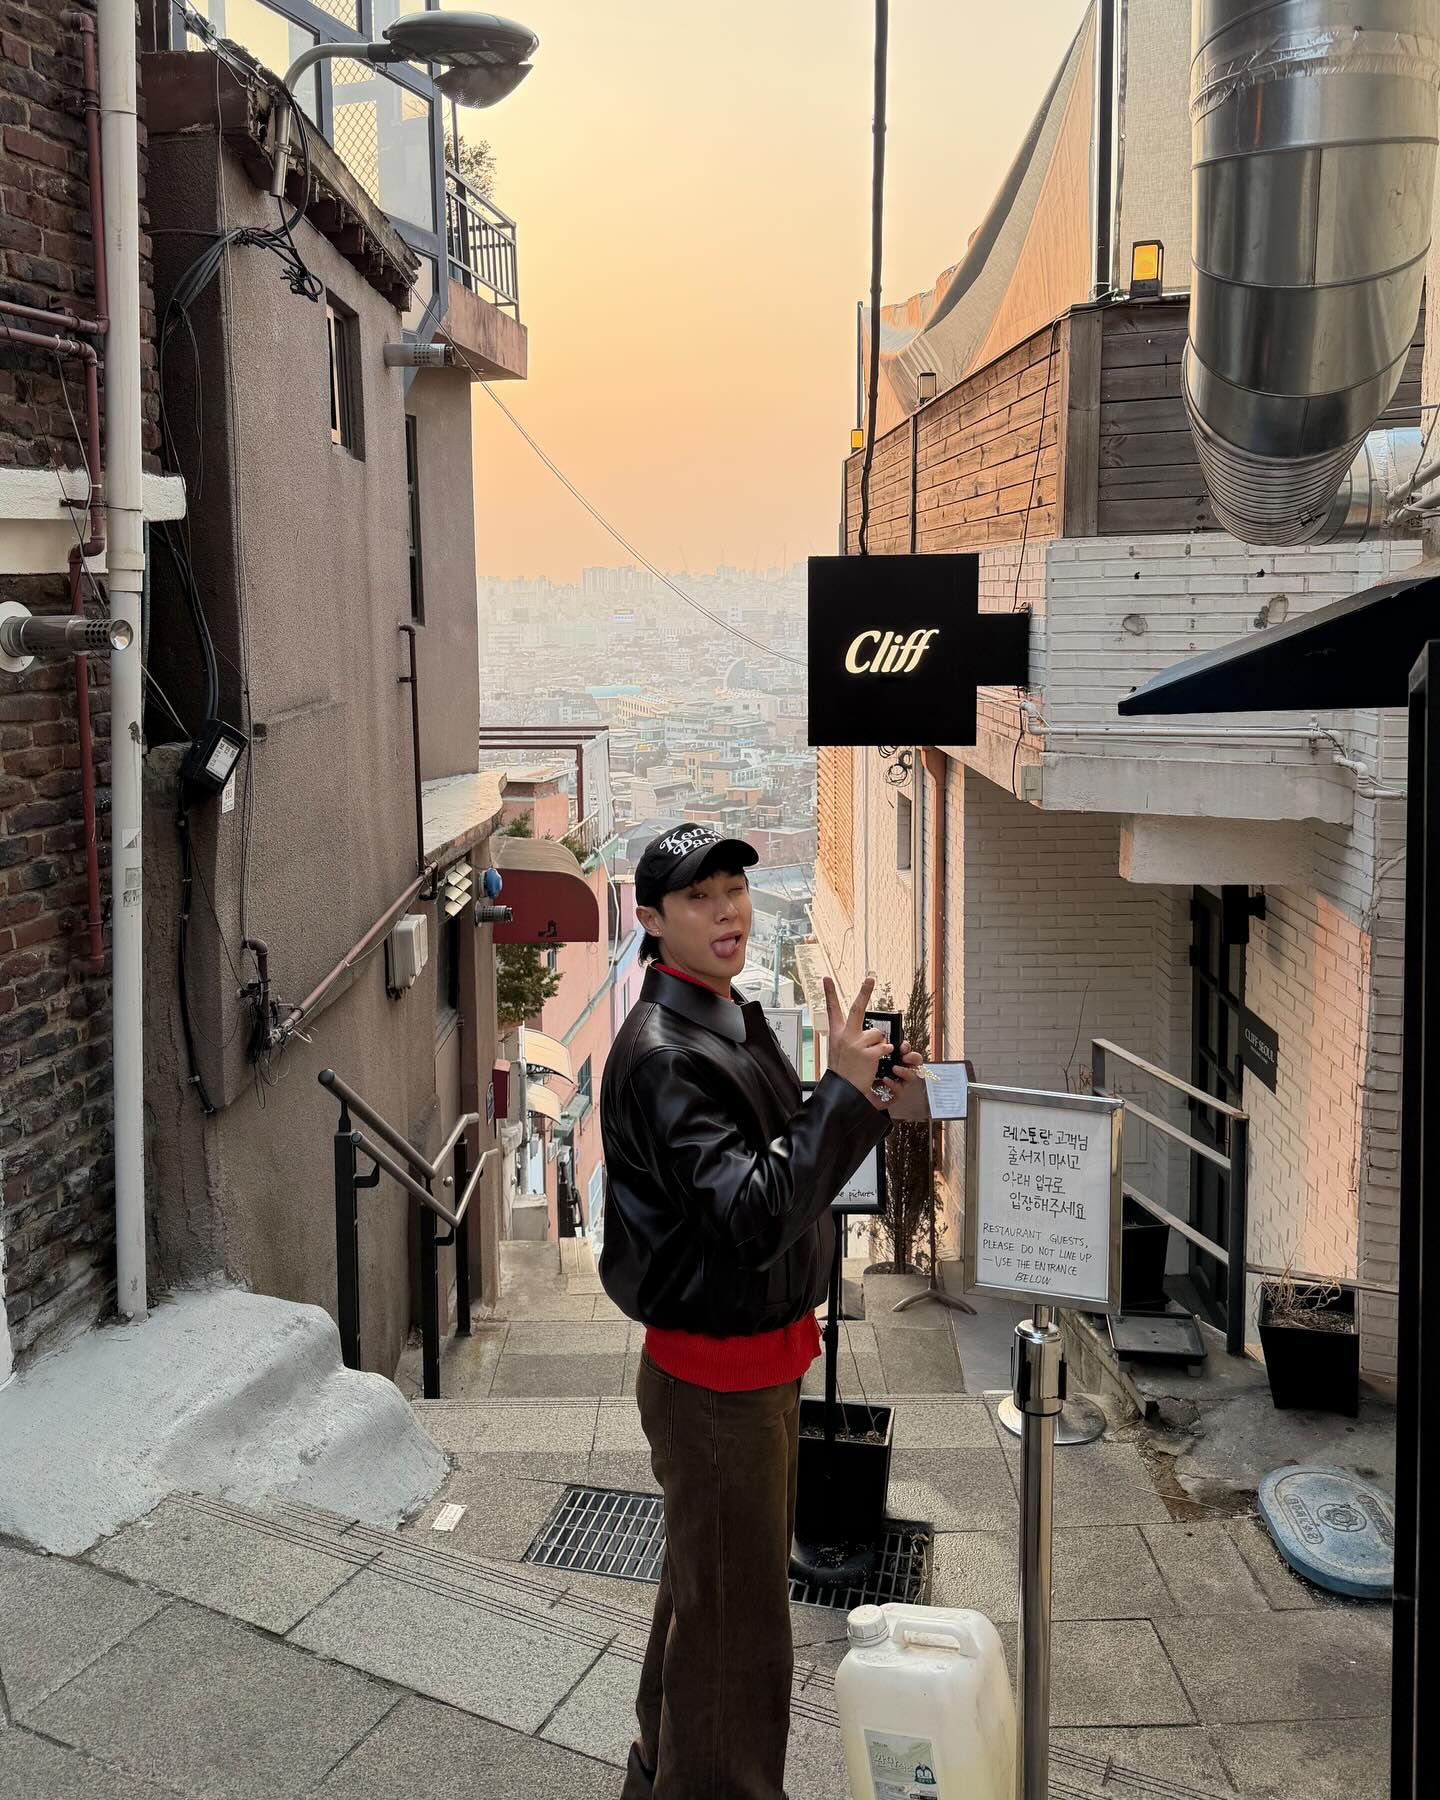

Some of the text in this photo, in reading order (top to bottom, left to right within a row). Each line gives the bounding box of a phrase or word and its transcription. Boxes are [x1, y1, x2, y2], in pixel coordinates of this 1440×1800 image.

[845, 629, 940, 674] Cliff
[1002, 1125, 1089, 1152] 레스토랑 고객님
[1007, 1145, 1081, 1170] 줄서지 마시고
[1001, 1171, 1066, 1195] 아래 입구로
[1009, 1192, 1087, 1220] 입장해주세요
[983, 1222, 1089, 1249] RESTAURANT GUESTS,
[982, 1238, 1093, 1263] PLEASE DO NOT LINE UP
[995, 1255, 1013, 1268] USE
[1016, 1258, 1031, 1269] THE
[1034, 1260, 1078, 1277] ENTRANCE
